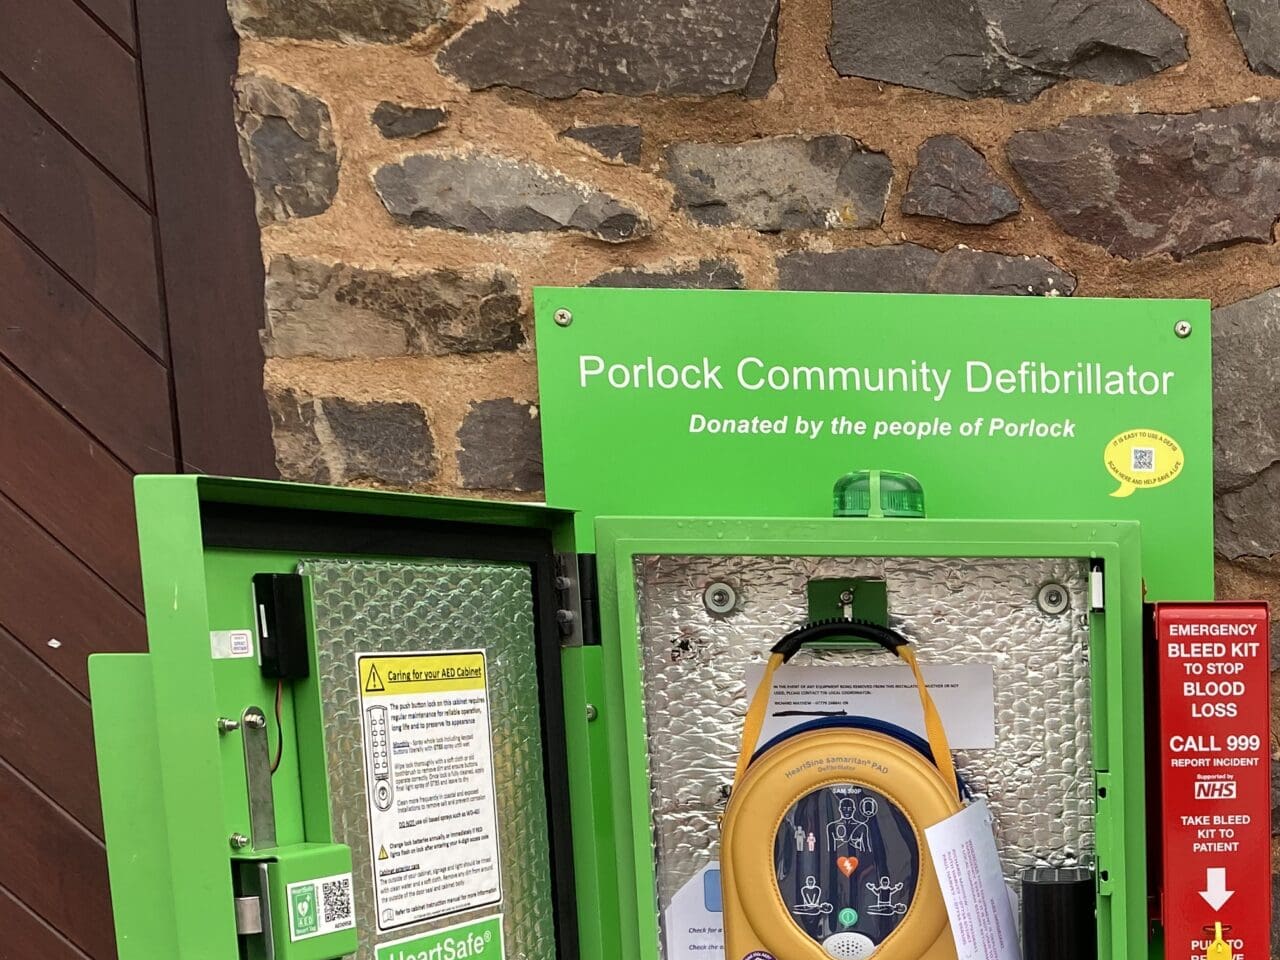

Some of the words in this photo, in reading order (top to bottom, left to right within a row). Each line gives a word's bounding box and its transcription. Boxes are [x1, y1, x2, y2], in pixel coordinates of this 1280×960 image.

[579, 355, 723, 389] Porlock
[737, 357, 951, 401] Community
[966, 360, 1174, 395] Defibrillator
[689, 414, 788, 434] Donated
[795, 415, 823, 439] by
[831, 416, 867, 435] the
[873, 418, 952, 440] people
[959, 418, 984, 437] of
[988, 418, 1076, 438] Porlock
[1169, 624, 1258, 636] EMERGENCY
[1168, 643, 1227, 658] BLEED
[1231, 643, 1259, 657] KIT
[388, 671, 410, 682] Caring
[412, 669, 423, 680] for
[424, 670, 440, 680] your
[441, 668, 456, 678] AED
[457, 667, 481, 677] Cabinet
[1184, 663, 1203, 675] TO
[1207, 662, 1244, 675] STOP
[1183, 682, 1245, 696] BLOOD
[1192, 703, 1238, 718] LOSS
[1169, 736, 1222, 752] CALL
[1226, 735, 1260, 751] 999
[785, 759, 824, 778] HeartSine
[871, 762, 889, 775] PAD
[1171, 758, 1211, 767] REPORT
[1213, 757, 1259, 766] INCIDENT
[1196, 783, 1234, 798] NHS
[1181, 816, 1210, 825] TAKE
[1213, 815, 1250, 824] BLEED
[1198, 829, 1216, 838] KIT
[1219, 829, 1235, 838] TO
[1193, 842, 1239, 852] PATIENT
[707, 927, 717, 935] for
[1227, 939, 1243, 949] TO
